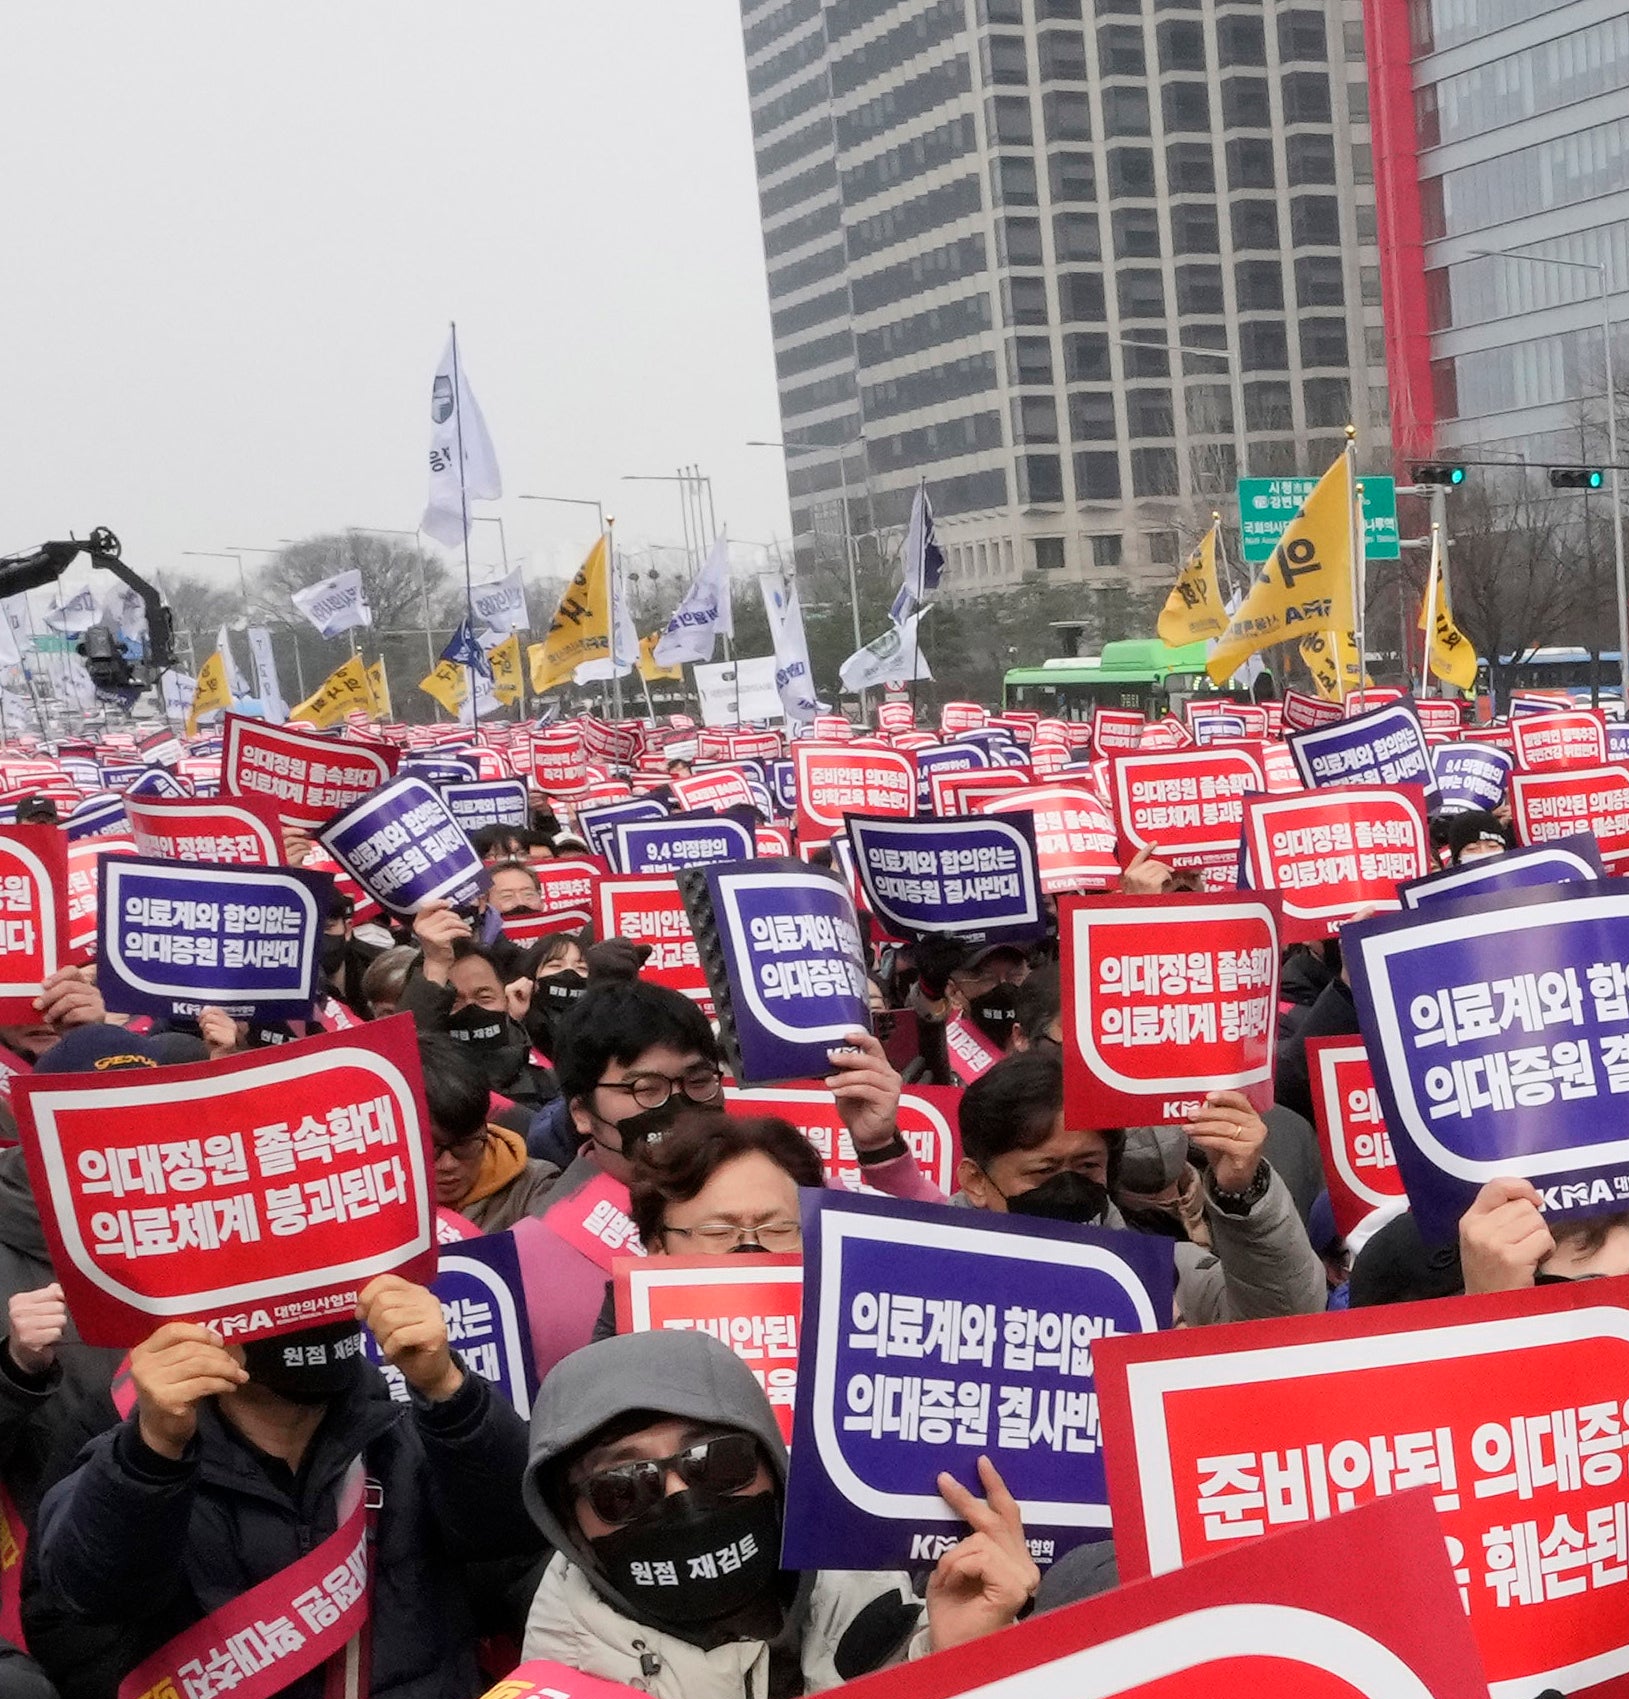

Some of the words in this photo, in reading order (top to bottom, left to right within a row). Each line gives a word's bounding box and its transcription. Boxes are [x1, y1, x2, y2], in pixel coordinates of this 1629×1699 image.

[242, 745, 306, 779] 의대정원
[309, 759, 377, 789] 졸속확대
[1311, 744, 1374, 778] 의료계와
[1372, 726, 1417, 762] 합의없는
[240, 767, 305, 804] 의료체계
[811, 768, 863, 787] 준비안된
[1131, 778, 1197, 804] 의대정원
[811, 788, 865, 808] 의학교육
[1527, 798, 1587, 820] 준비안된
[1134, 805, 1201, 832] 의료체계
[646, 843, 671, 858] 9.4
[673, 838, 728, 858] 의정합의
[1273, 822, 1354, 858] 의대정원
[1355, 820, 1413, 849] 졸속확대
[868, 847, 939, 878] 의료계와
[941, 845, 1016, 876] 합의없는
[1172, 856, 1203, 868] KMA
[1277, 855, 1358, 890] 의료체계
[1360, 852, 1416, 880] 붕괴된다
[875, 875, 943, 906] 의대증원
[944, 874, 1020, 906] 결사반대
[125, 896, 219, 929] 의료계와
[223, 902, 302, 936] 합의없는
[750, 914, 838, 954] 의료계와
[125, 934, 219, 968] 의대증원
[222, 937, 298, 969] 결사반대
[761, 959, 853, 1001] 의대증원
[1100, 955, 1214, 997] 의대정원
[1217, 947, 1272, 990] 졸속확대
[1100, 1005, 1216, 1048] 의료체계
[1220, 996, 1270, 1042] 붕괴된다
[1410, 968, 1584, 1049] 의료계와
[1424, 1039, 1597, 1121] 의대증원
[77, 1132, 250, 1199] 의대정원
[253, 1094, 399, 1179] 졸속확대
[90, 1192, 262, 1260] 의료체계
[265, 1155, 407, 1237] 붕괴된다
[274, 1290, 358, 1319] 대한의사협회
[848, 1290, 998, 1368] 의료계와
[283, 1345, 328, 1368] 원점
[843, 1379, 989, 1447] 의대증원
[1196, 1424, 1462, 1543] 준비안된
[630, 1559, 680, 1586] 원점
[688, 1532, 760, 1581] 재검토
